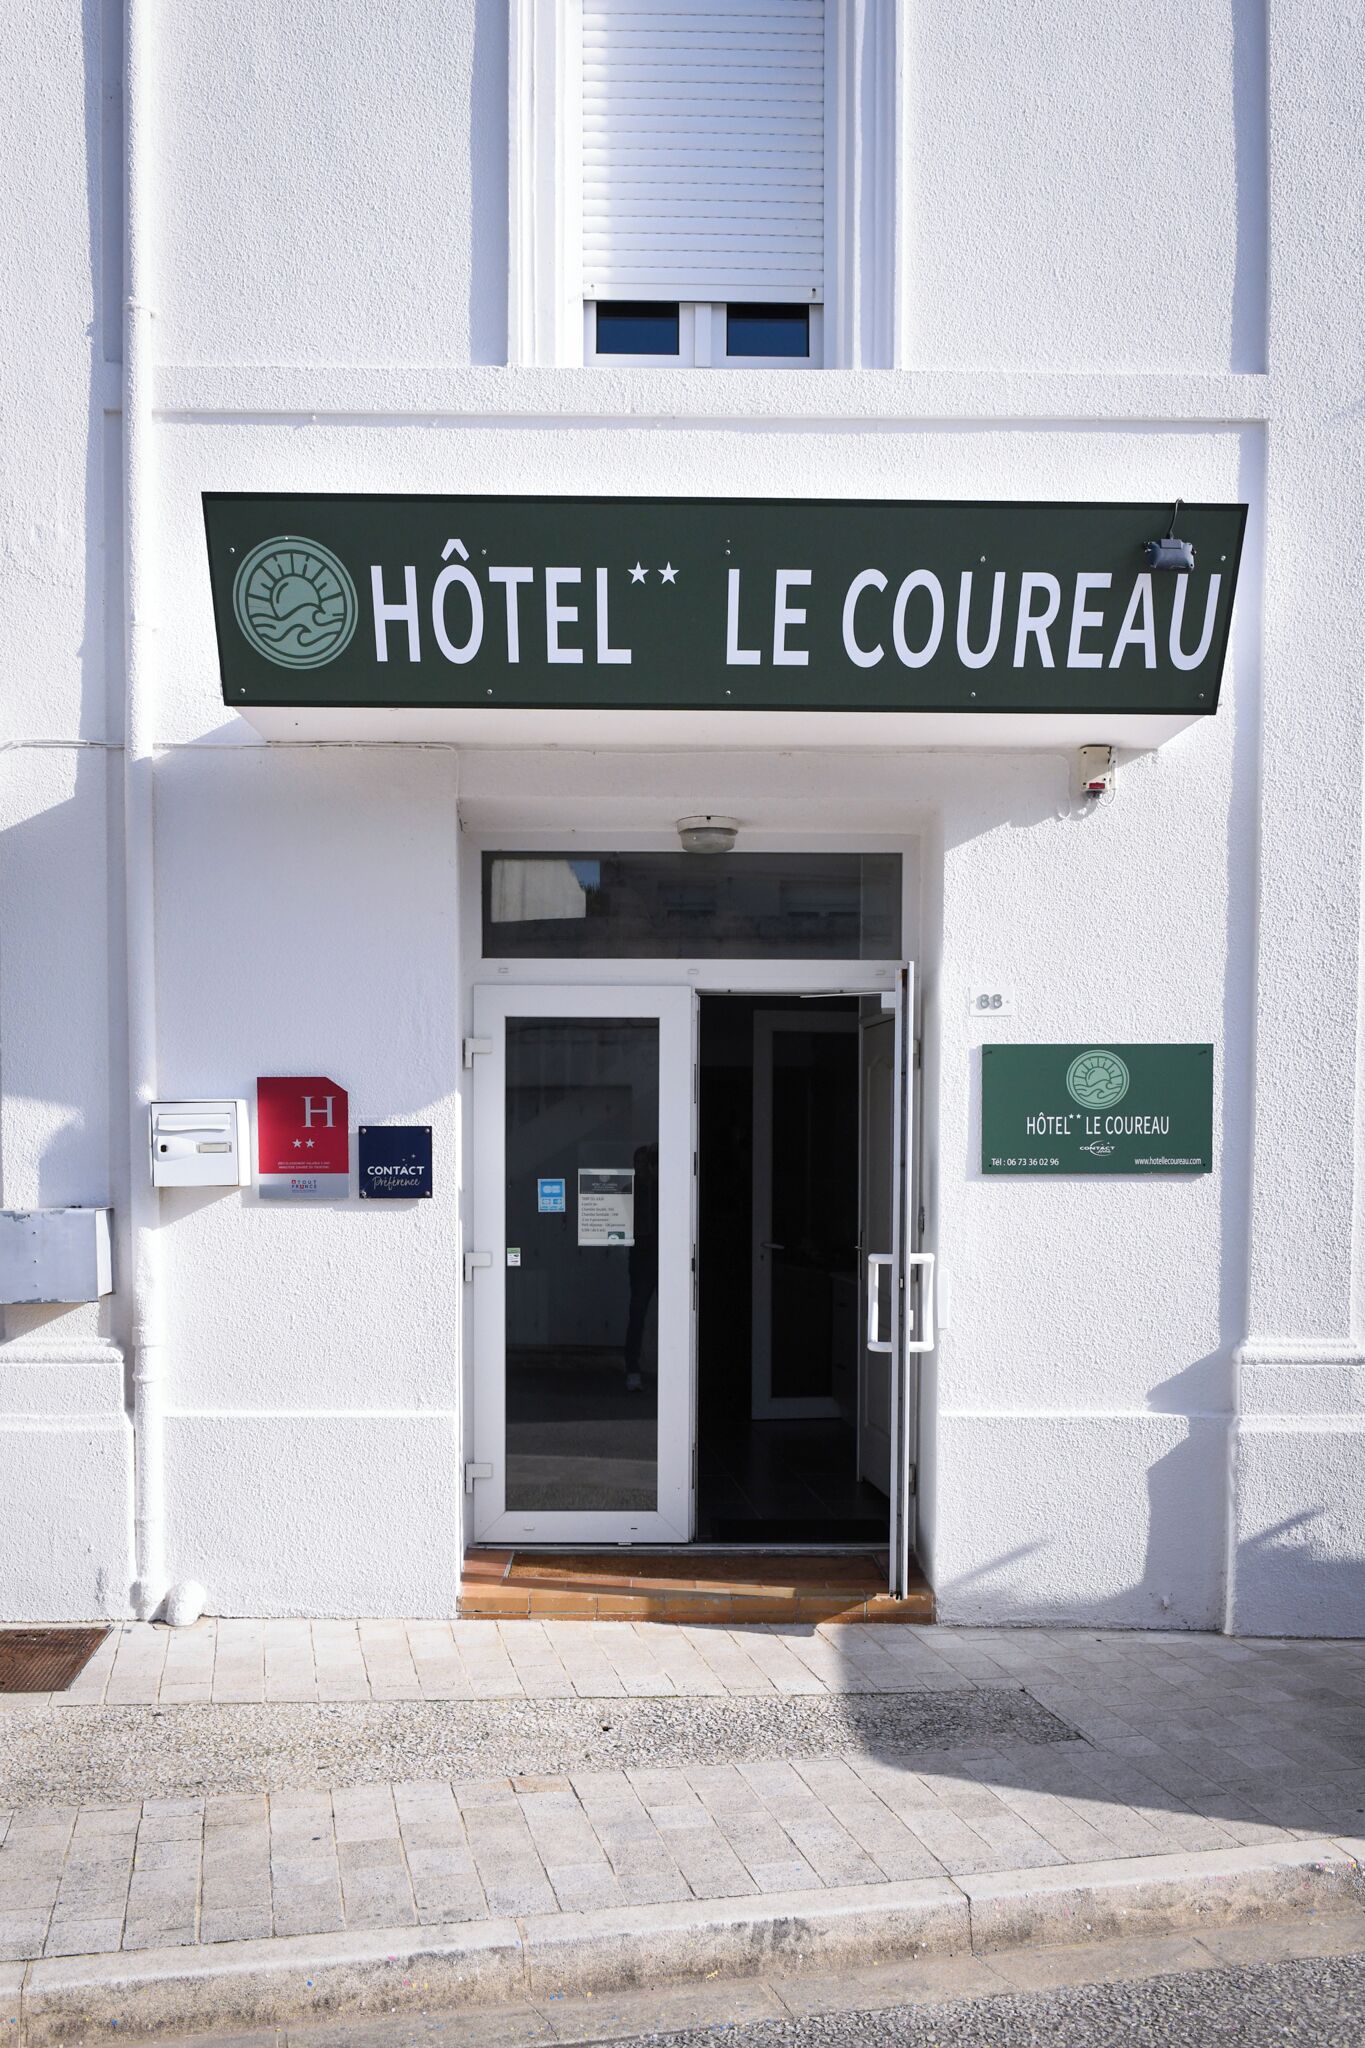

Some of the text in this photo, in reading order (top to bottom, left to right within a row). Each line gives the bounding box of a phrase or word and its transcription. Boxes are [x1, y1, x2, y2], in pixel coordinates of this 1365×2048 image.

[370, 538, 1222, 671] HÔTEL LE COUREAU
[301, 1095, 337, 1128] H
[1026, 1111, 1170, 1135] HÔTEL LE COUREAU
[1006, 1158, 1017, 1166] 06
[1018, 1158, 1027, 1166] 73
[1028, 1158, 1038, 1166] 36
[1038, 1158, 1048, 1166] 02
[1050, 1158, 1060, 1166] 96
[1134, 1156, 1202, 1165] www.hotellecoureau.com
[367, 1165, 425, 1176] CONTACT
[372, 1175, 420, 1191] Préférence
